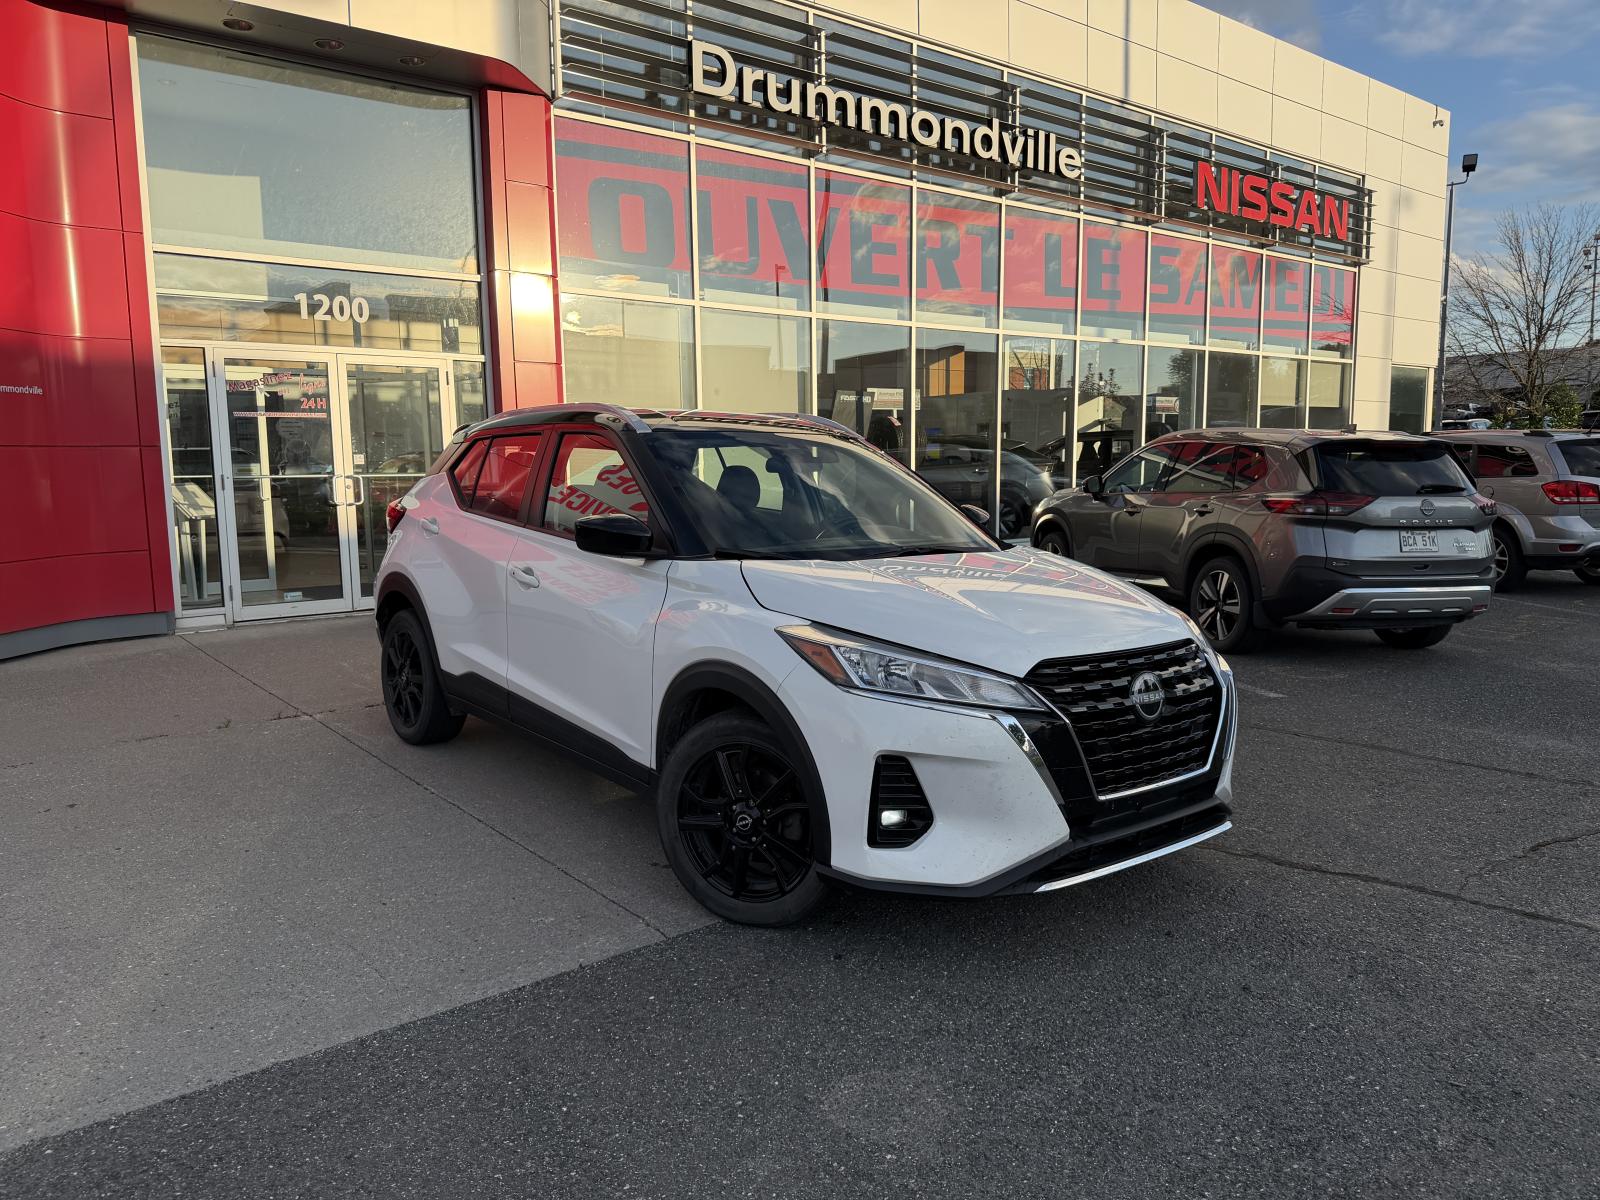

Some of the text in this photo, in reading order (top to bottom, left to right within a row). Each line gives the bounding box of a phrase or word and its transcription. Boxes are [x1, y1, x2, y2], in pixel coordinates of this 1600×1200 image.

[691, 40, 1082, 180] Drummondville
[1197, 160, 1348, 241] NISSAN
[588, 176, 1345, 313] OUVERT LE SAMEDI
[294, 293, 370, 323] 1200
[228, 371, 293, 393] Magasinez
[1402, 535, 1438, 547] BCA 51K
[1131, 690, 1165, 705] NISSAN
